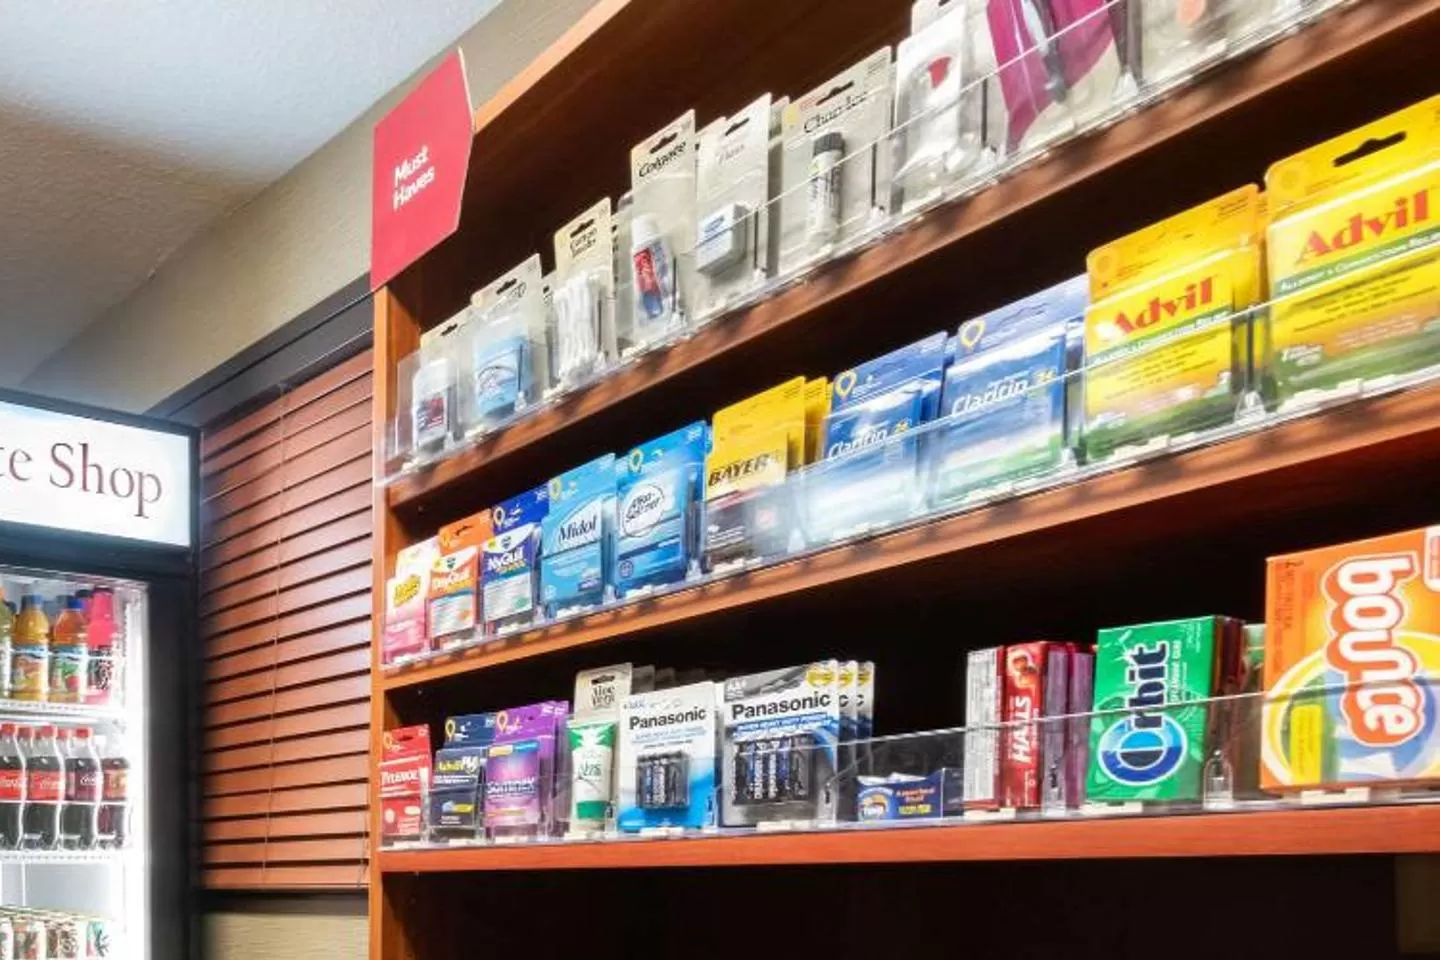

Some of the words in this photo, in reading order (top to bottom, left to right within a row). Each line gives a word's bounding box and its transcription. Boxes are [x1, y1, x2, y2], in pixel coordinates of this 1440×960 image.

[394, 146, 429, 184] Must
[639, 141, 687, 177] Colgate
[393, 170, 435, 209] Haves
[1296, 190, 1430, 265] Advil
[1114, 276, 1215, 335] Advil
[950, 378, 1029, 417] Claritin
[828, 423, 888, 460] Claritin
[49, 443, 162, 519] Shop
[708, 453, 771, 487] BAYER
[560, 514, 598, 540] Midol
[1336, 555, 1417, 736] bounce
[629, 706, 706, 731] Panasonic
[732, 691, 831, 720] Panasonic
[1098, 638, 1188, 785] Orbit
[1012, 695, 1033, 764] HALLS
